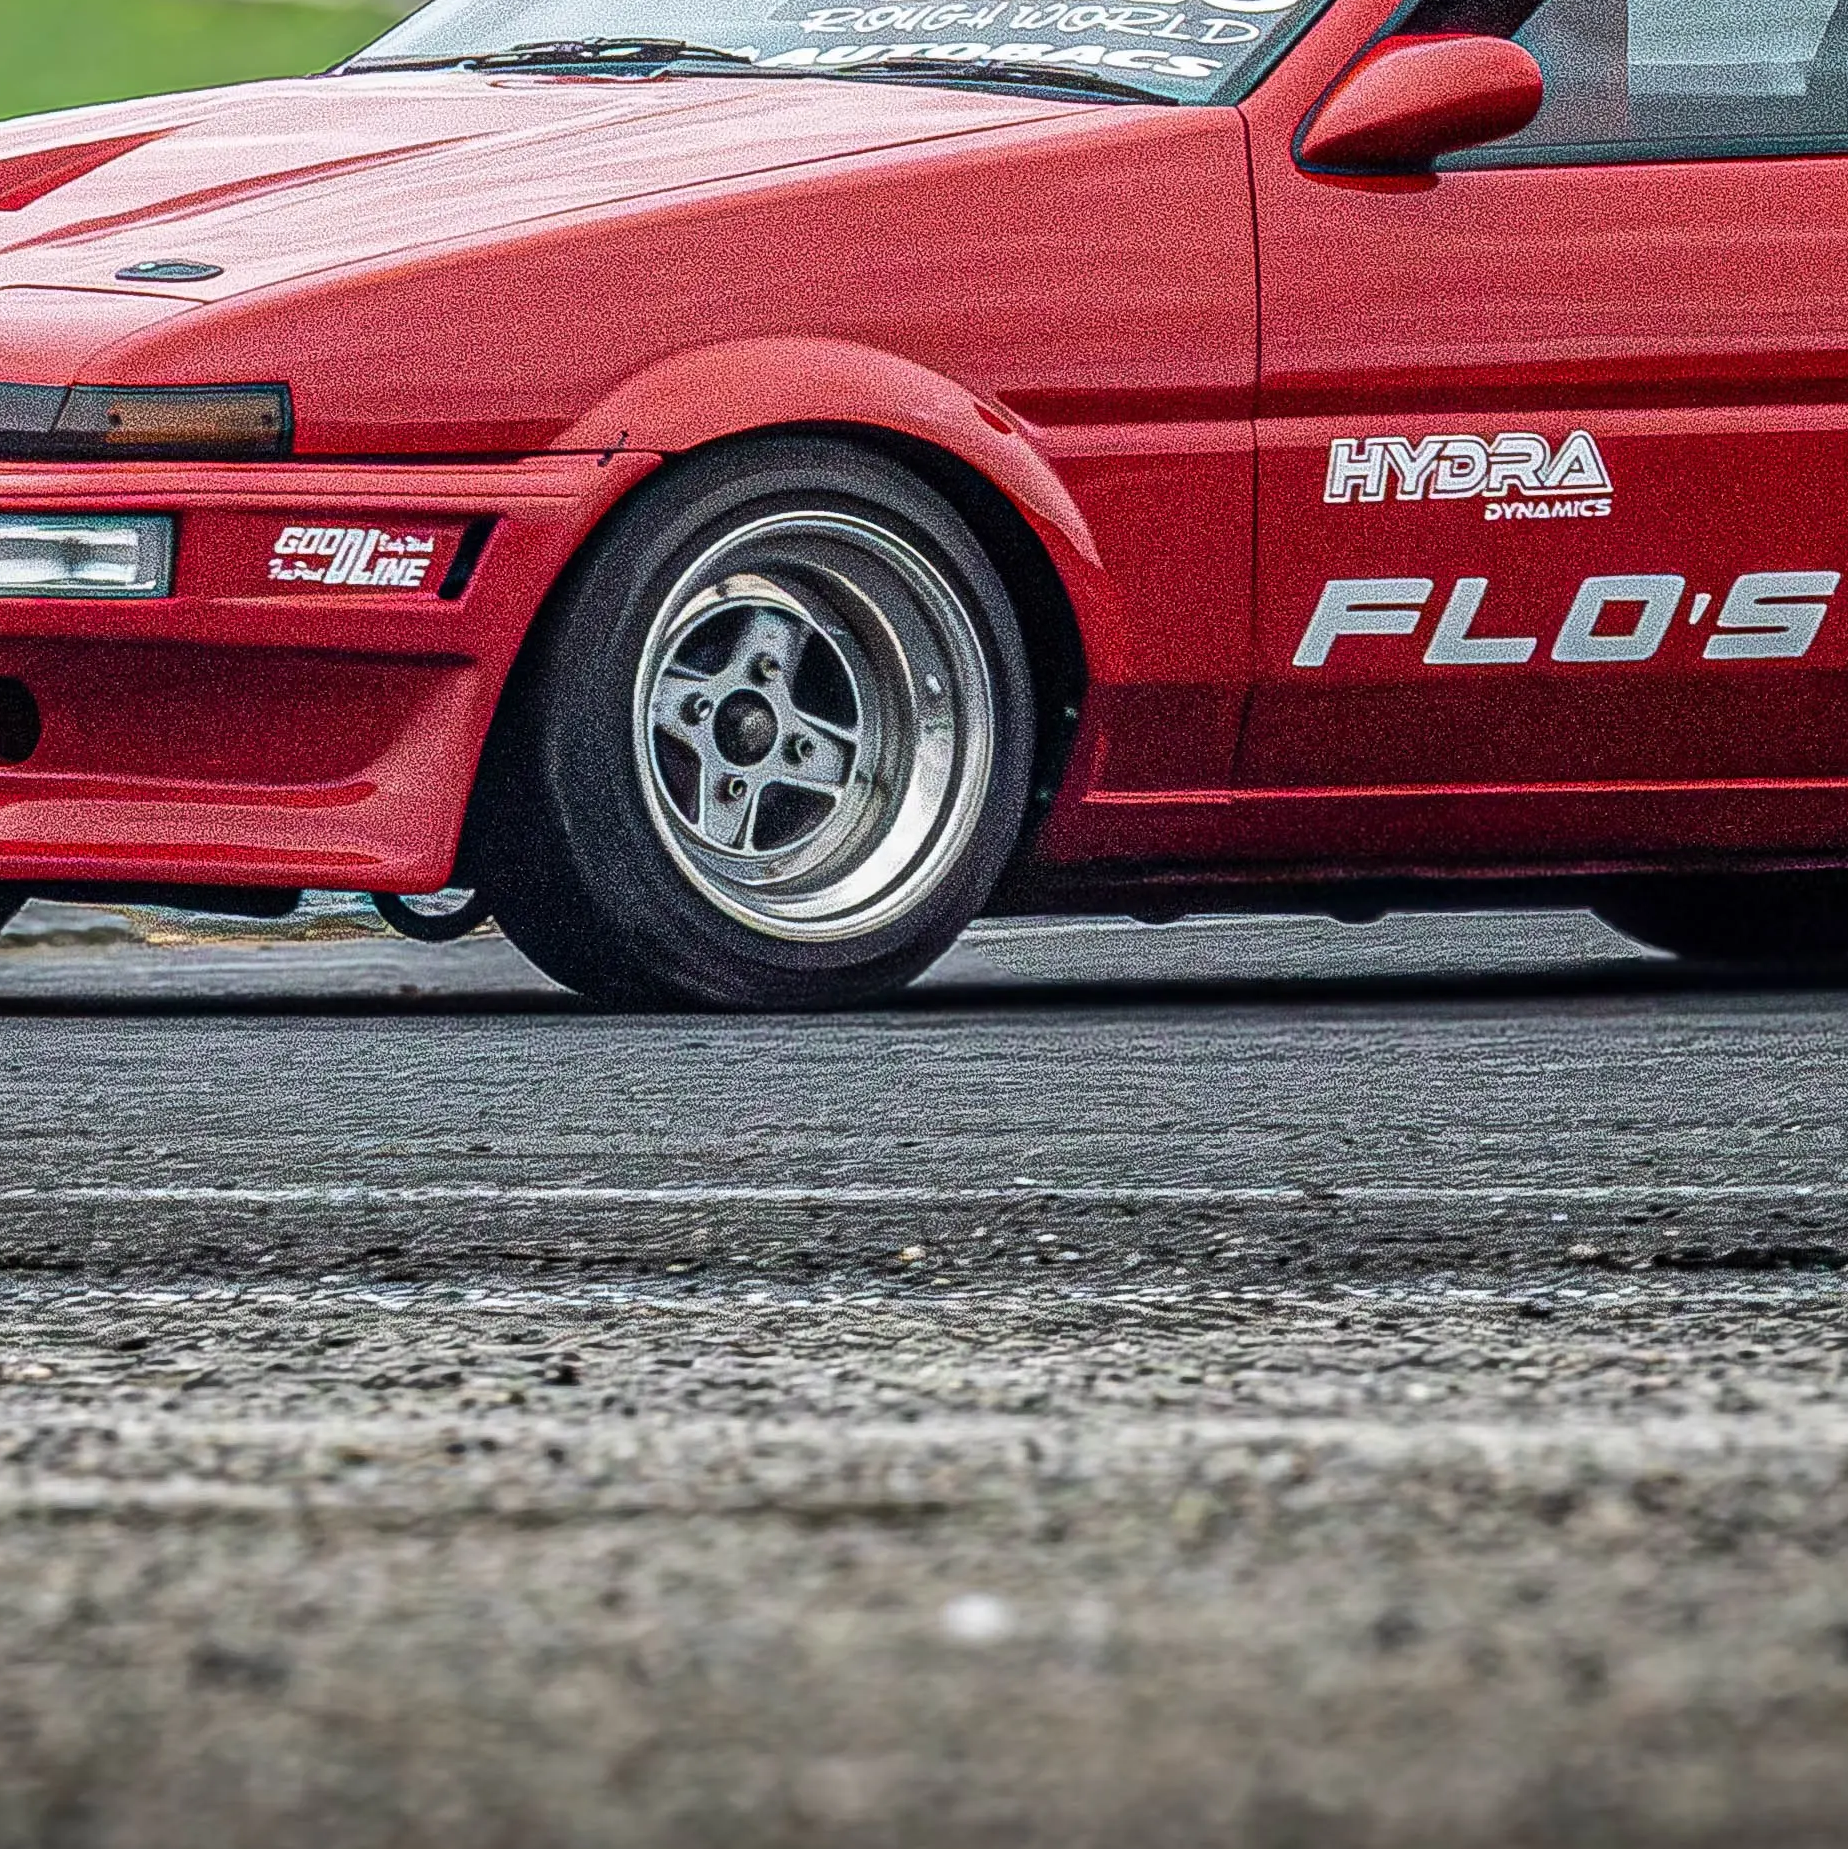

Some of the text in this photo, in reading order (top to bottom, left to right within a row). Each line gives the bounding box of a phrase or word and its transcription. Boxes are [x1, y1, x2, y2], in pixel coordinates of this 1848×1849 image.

[801, 3, 1261, 44] ROUGH WORLD
[1323, 430, 1613, 504] HYDRA
[1484, 498, 1612, 521] DYNAMICS
[1292, 571, 1841, 667] FLO'S
